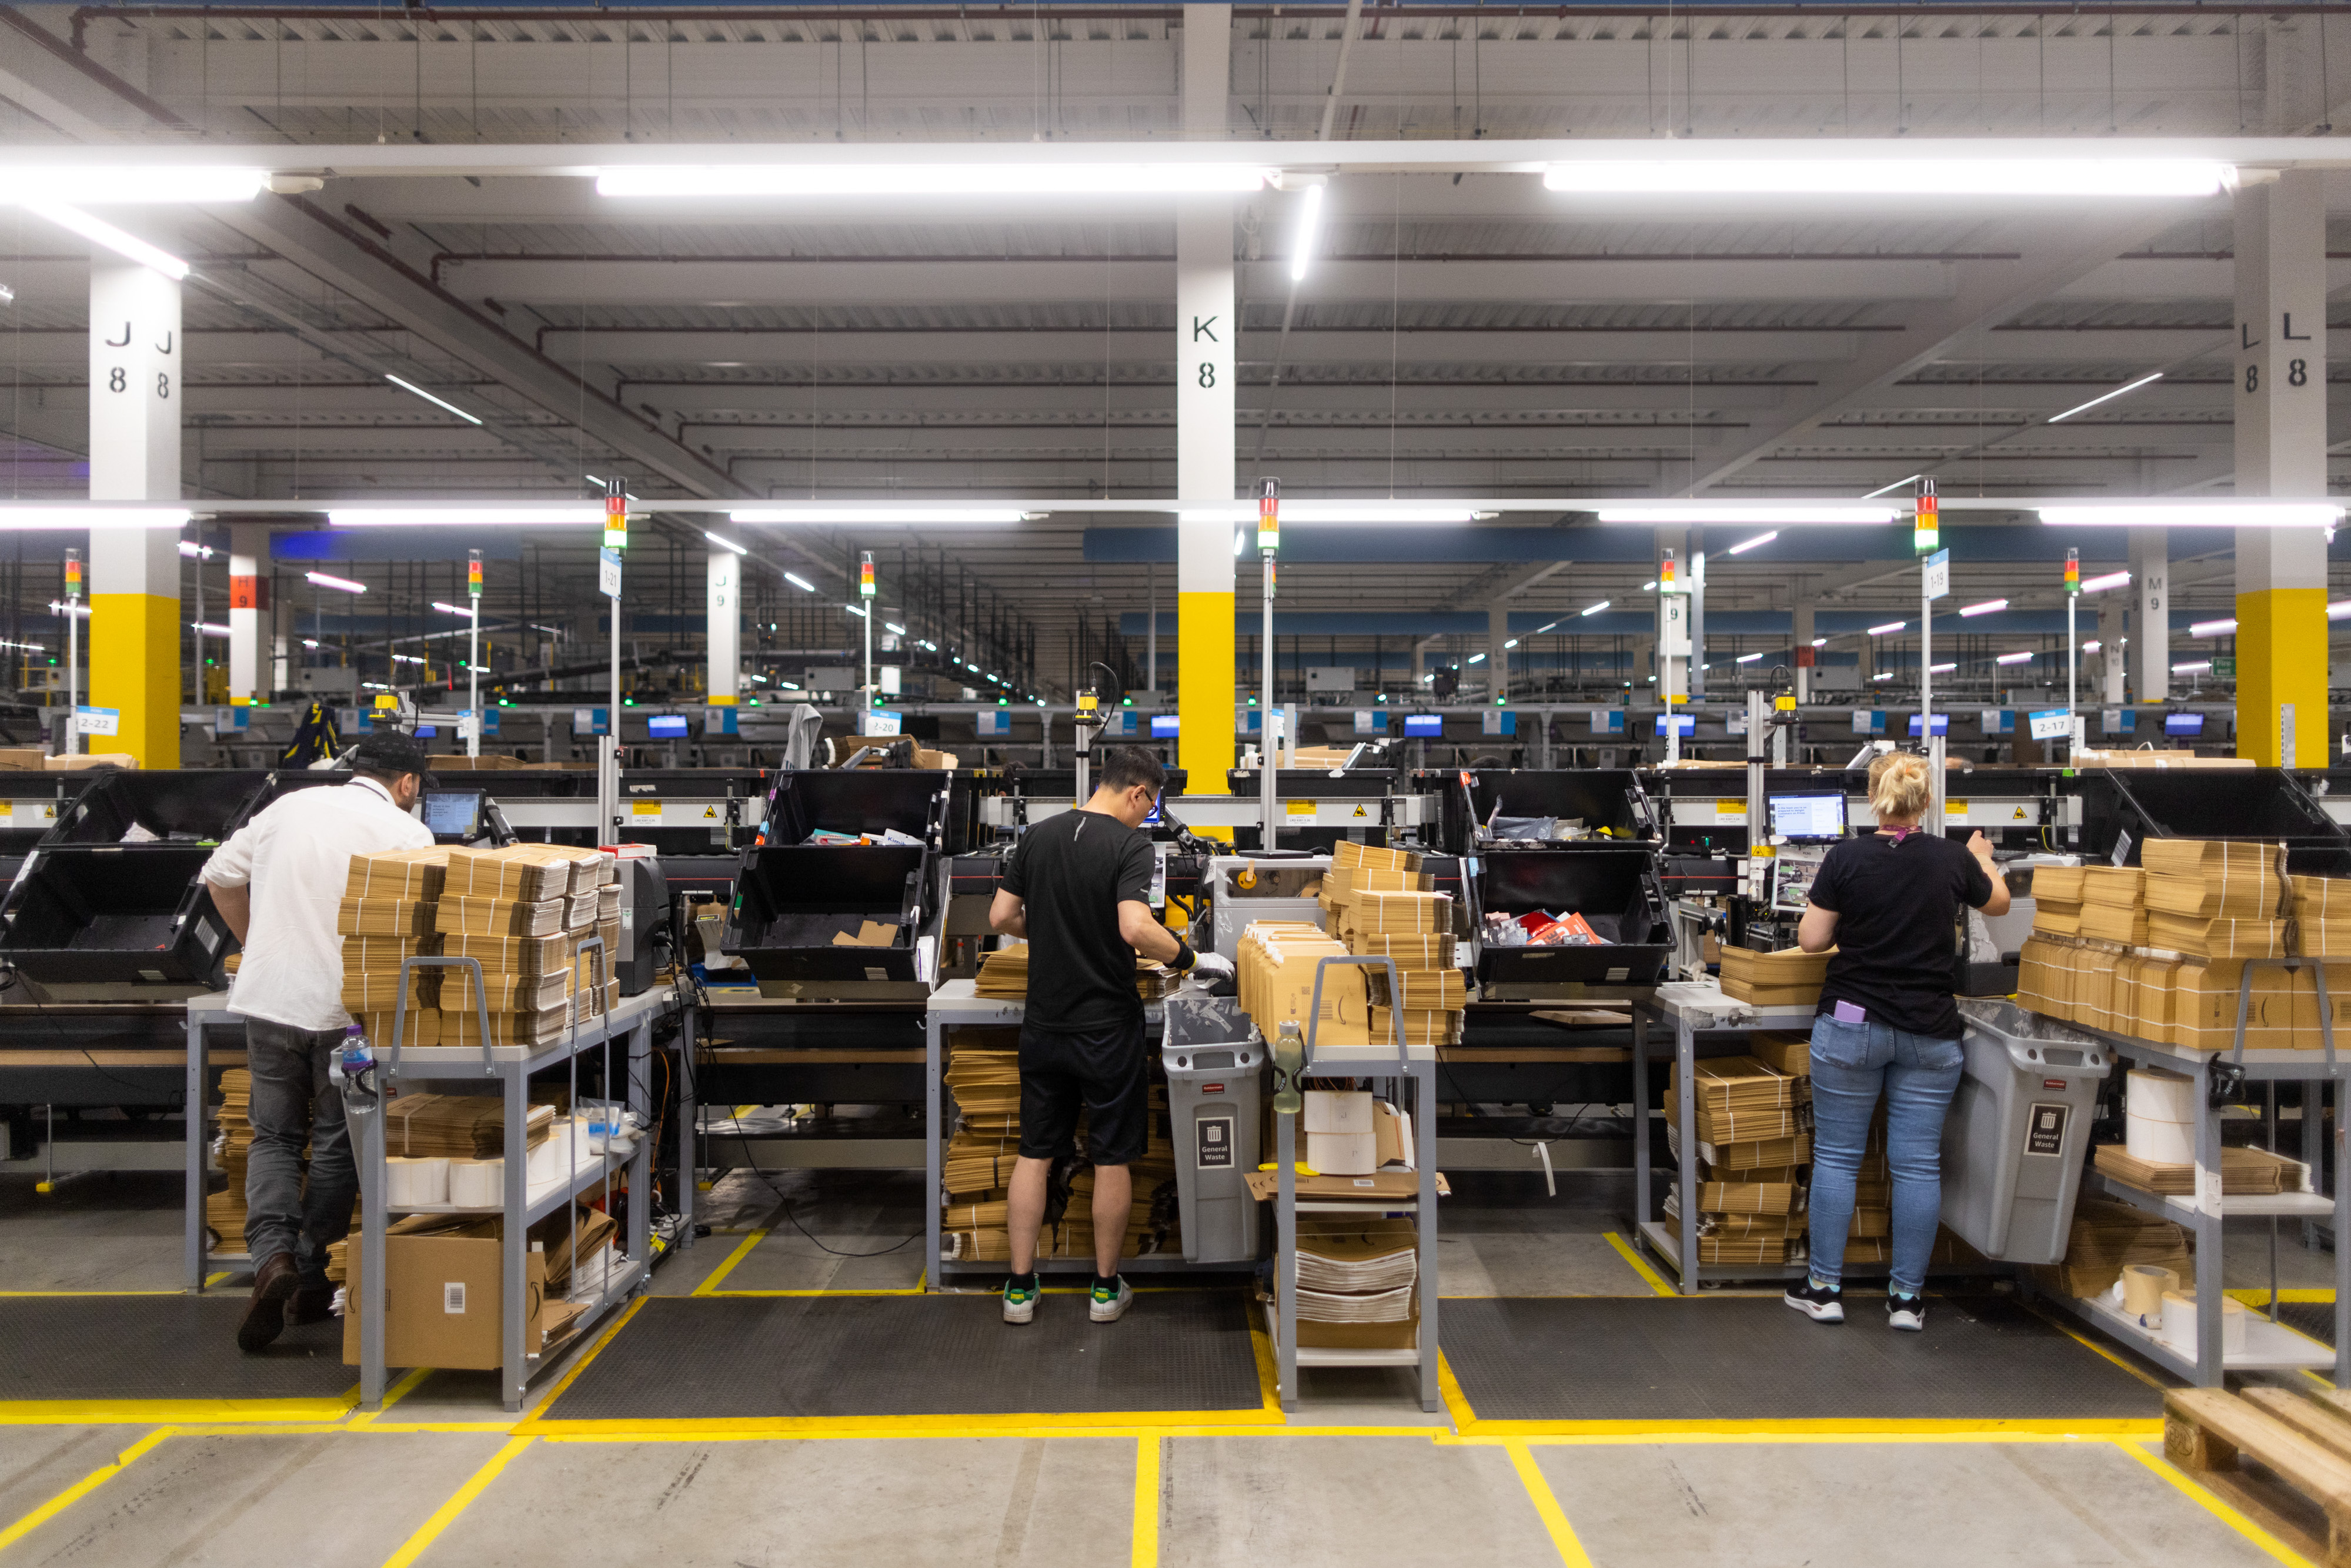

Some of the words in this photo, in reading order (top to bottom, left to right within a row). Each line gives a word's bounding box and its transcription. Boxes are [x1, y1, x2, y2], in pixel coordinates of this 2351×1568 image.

[105, 321, 131, 347] J
[1194, 316, 1218, 342] K
[2284, 312, 2311, 340] L
[155, 330, 171, 354] J
[2242, 323, 2260, 350] L
[109, 366, 126, 393] 8
[1198, 362, 1215, 389] 8
[2245, 365, 2258, 393] 8
[2289, 358, 2307, 386] 8
[157, 372, 169, 399] 8
[239, 576, 248, 587] H
[605, 570, 616, 587] 1-21
[715, 575, 726, 586] J
[1931, 571, 1943, 589] 1-19
[2148, 577, 2162, 590] M
[239, 595, 248, 607] 9
[717, 595, 724, 607] 9
[2150, 597, 2159, 610] 9
[1670, 608, 1678, 620] 9
[81, 718, 108, 728] 2-22
[2039, 721, 2064, 732] 2-17
